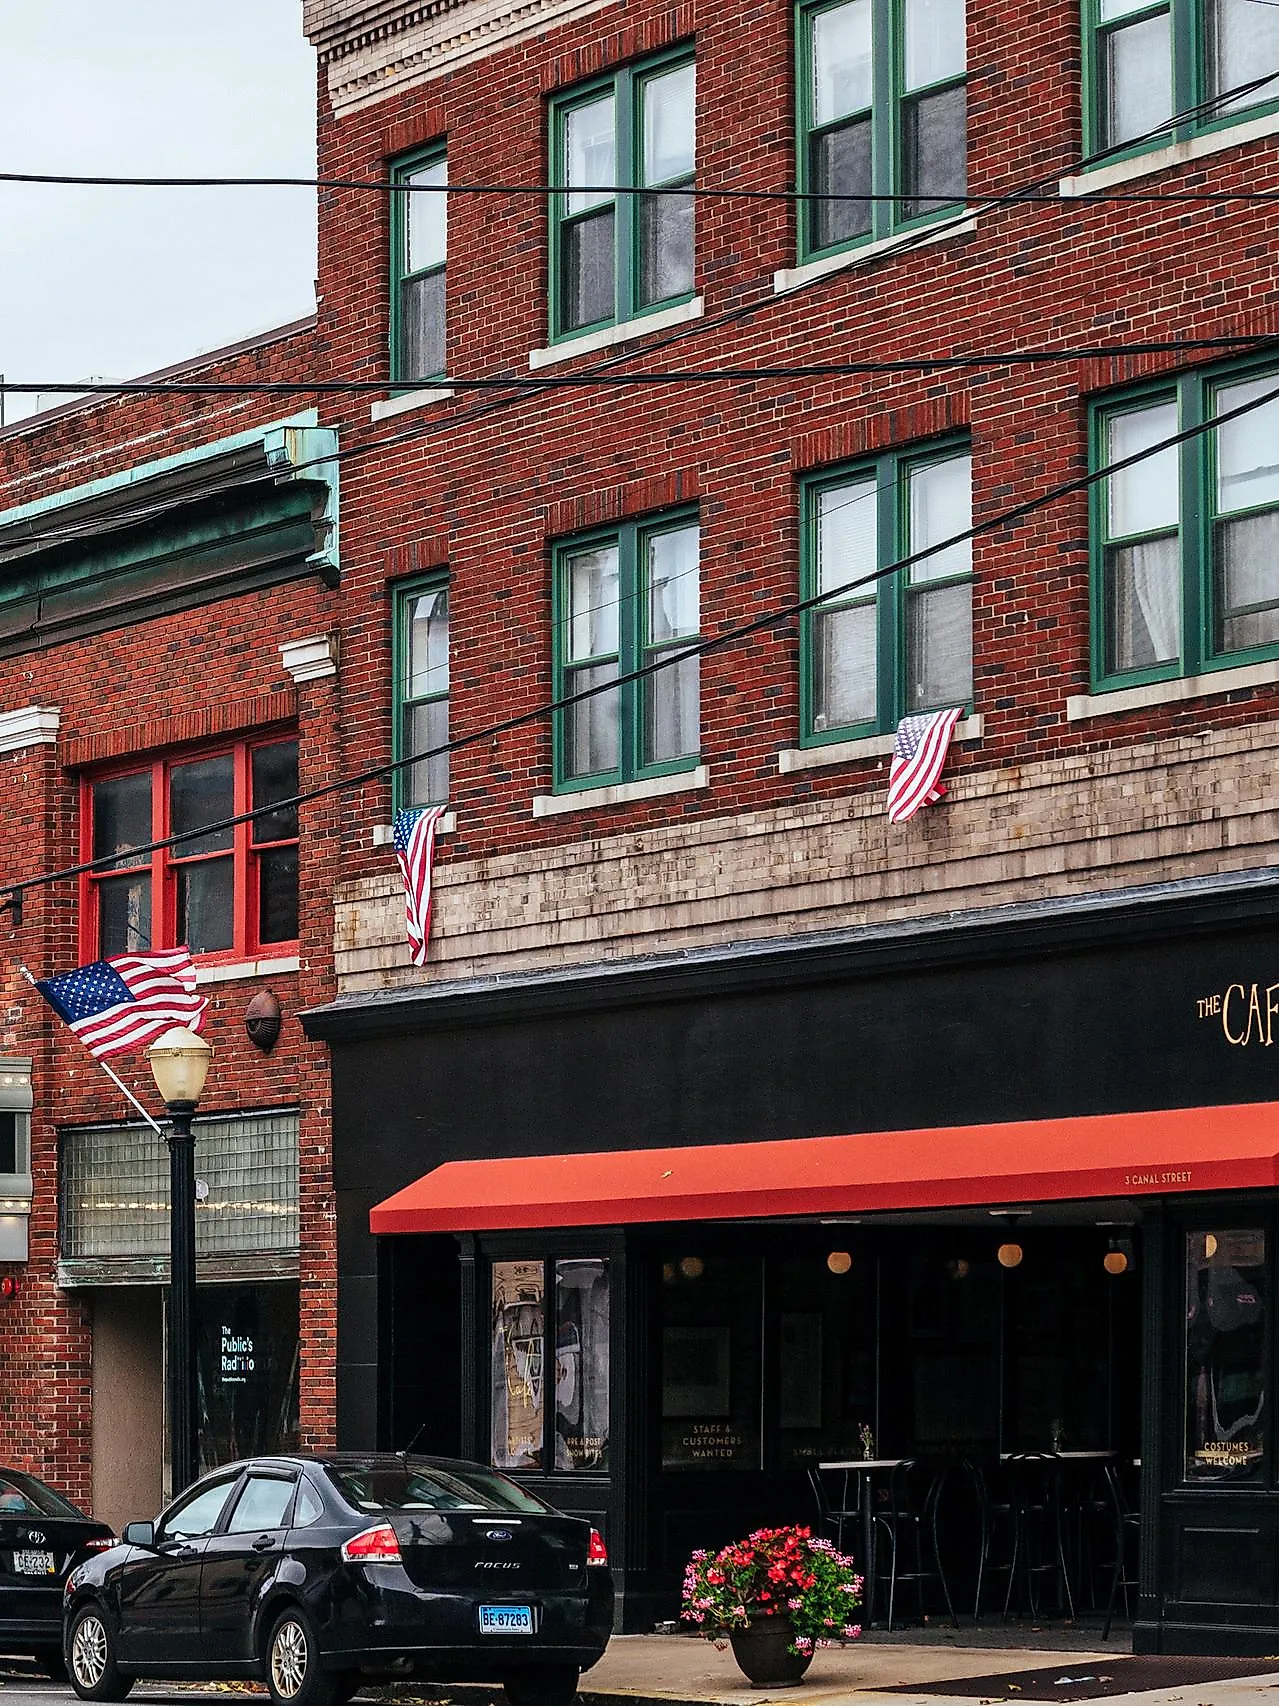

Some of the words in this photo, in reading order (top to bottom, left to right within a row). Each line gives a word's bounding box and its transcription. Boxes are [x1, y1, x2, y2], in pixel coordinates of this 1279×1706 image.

[1196, 994, 1221, 1018] THE
[1124, 1175, 1130, 1185] 3
[1132, 1174, 1160, 1185] CANAL
[1161, 1171, 1192, 1183] STREET
[221, 1325, 232, 1335] The
[221, 1336, 254, 1353] Public's
[692, 1424, 721, 1434] STAFF
[682, 1436, 742, 1446] CUSTOMERS
[1204, 1441, 1249, 1452] COSTUMES
[691, 1448, 733, 1457] WANTED
[1205, 1455, 1248, 1466] WELCOME
[474, 1561, 521, 1569] FOCUS
